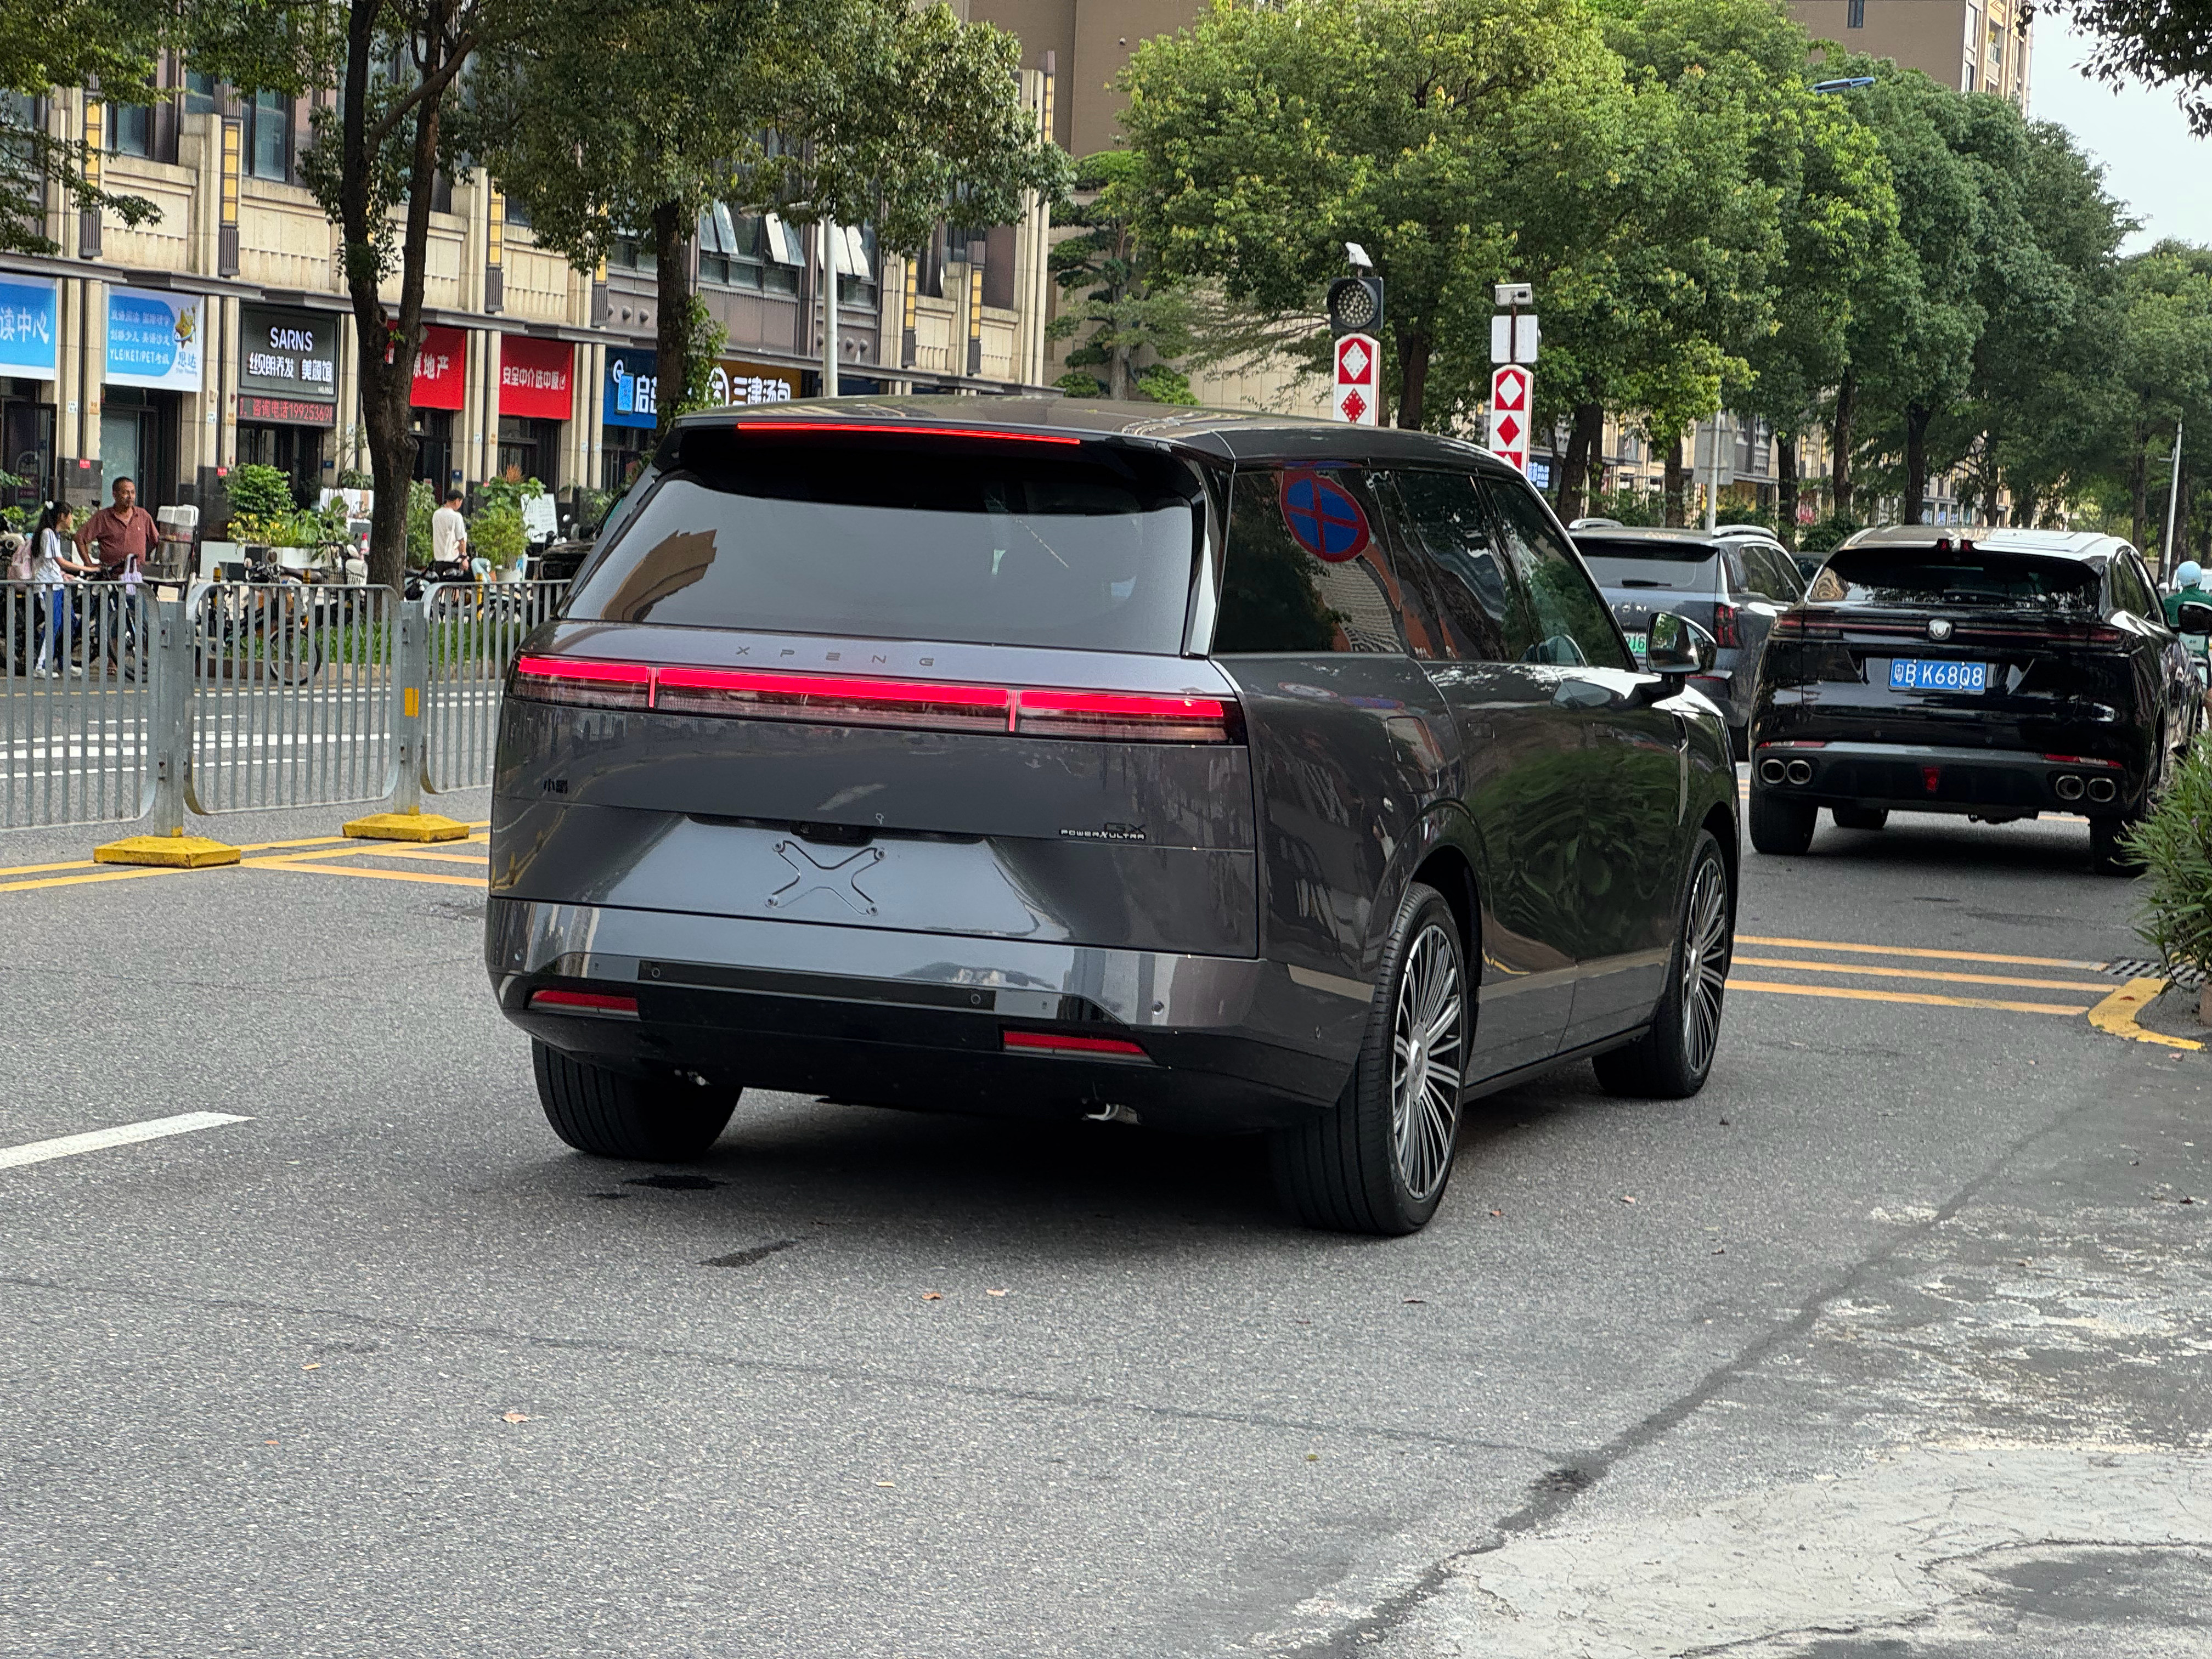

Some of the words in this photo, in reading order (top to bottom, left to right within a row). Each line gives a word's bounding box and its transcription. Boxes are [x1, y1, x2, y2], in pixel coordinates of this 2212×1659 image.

[270, 326, 313, 352] SARNS
[302, 358, 332, 382] 美颜馆
[736, 646, 934, 667] XPENG
